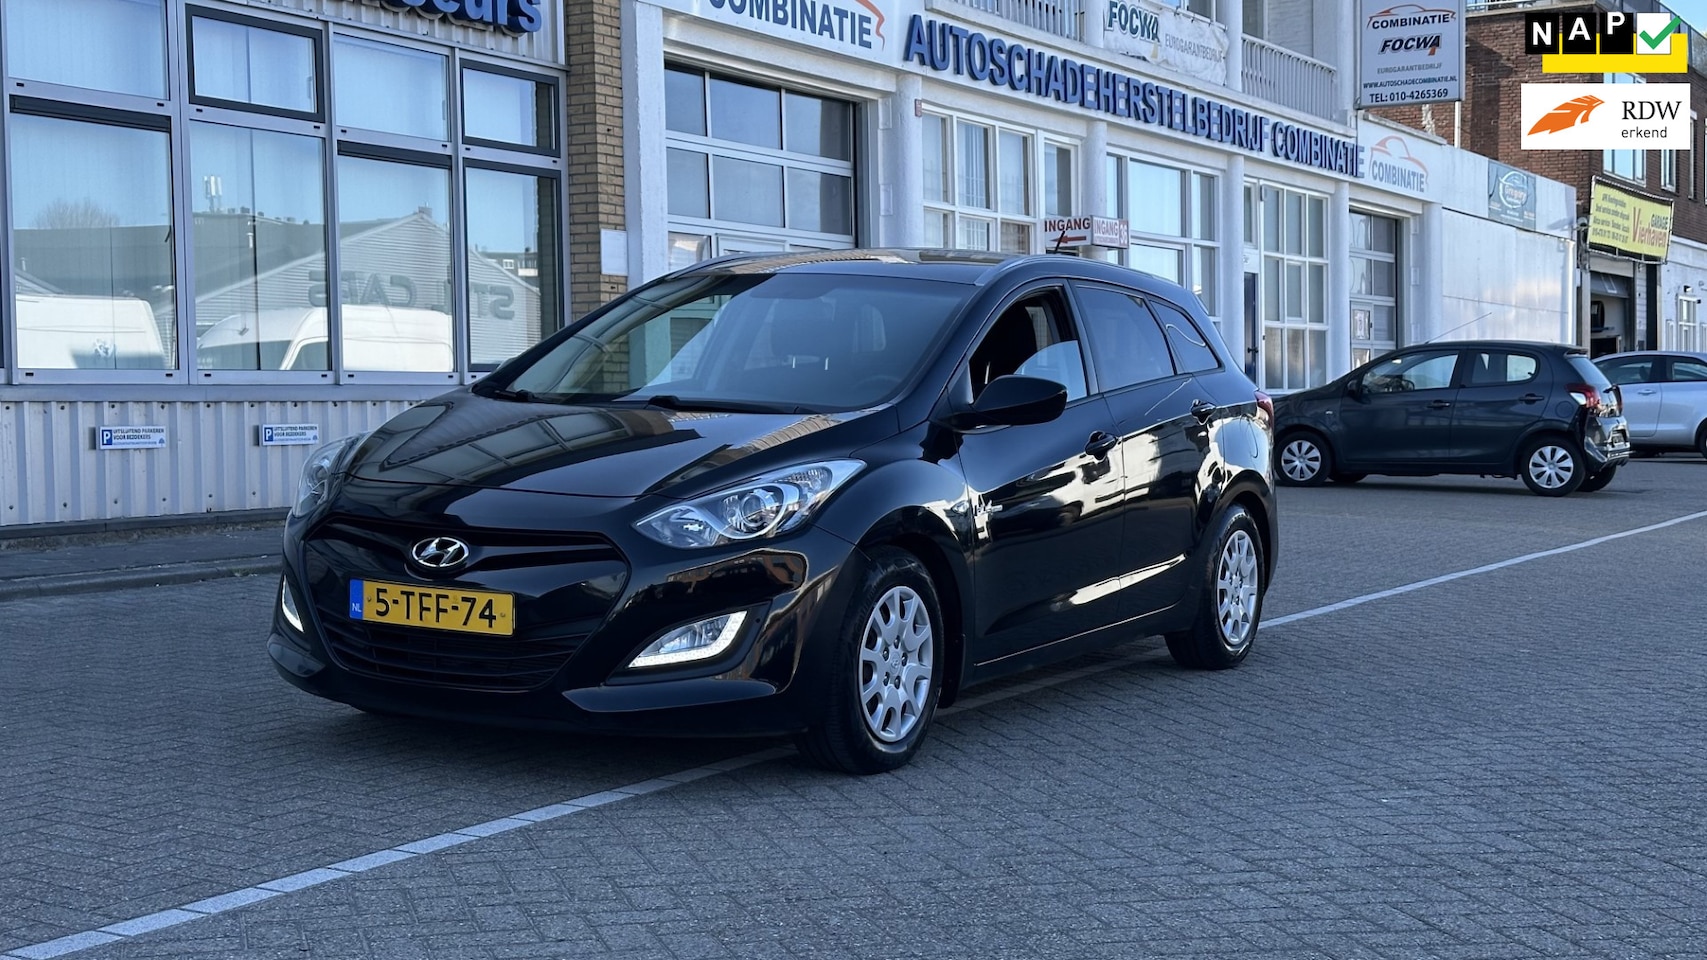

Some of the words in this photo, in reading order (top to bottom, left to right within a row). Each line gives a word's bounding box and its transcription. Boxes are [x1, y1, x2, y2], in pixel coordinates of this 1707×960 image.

[709, 0, 873, 49] MBINATIE
[1107, 0, 1161, 43] FOCWA
[1371, 13, 1450, 30] COMBINATIE
[1380, 34, 1441, 56] FOCWA
[1377, 62, 1443, 75] EUROGARANTBEDRIJF
[1363, 75, 1457, 89] WWW.AUTOSCHADECOMBINATIE.NL
[904, 14, 1270, 152] AUTOSCHADEHERSTELBEDRIJF
[1271, 121, 1365, 178] COMBINATIE
[1370, 93, 1388, 103] TEL:
[1389, 88, 1449, 101] 010-4265369
[1371, 160, 1425, 192] COMBINATIE
[1044, 217, 1091, 232] INGANG
[1094, 219, 1118, 236] INGANG
[351, 603, 362, 612] NL
[375, 588, 497, 628] 5-TFF-74
